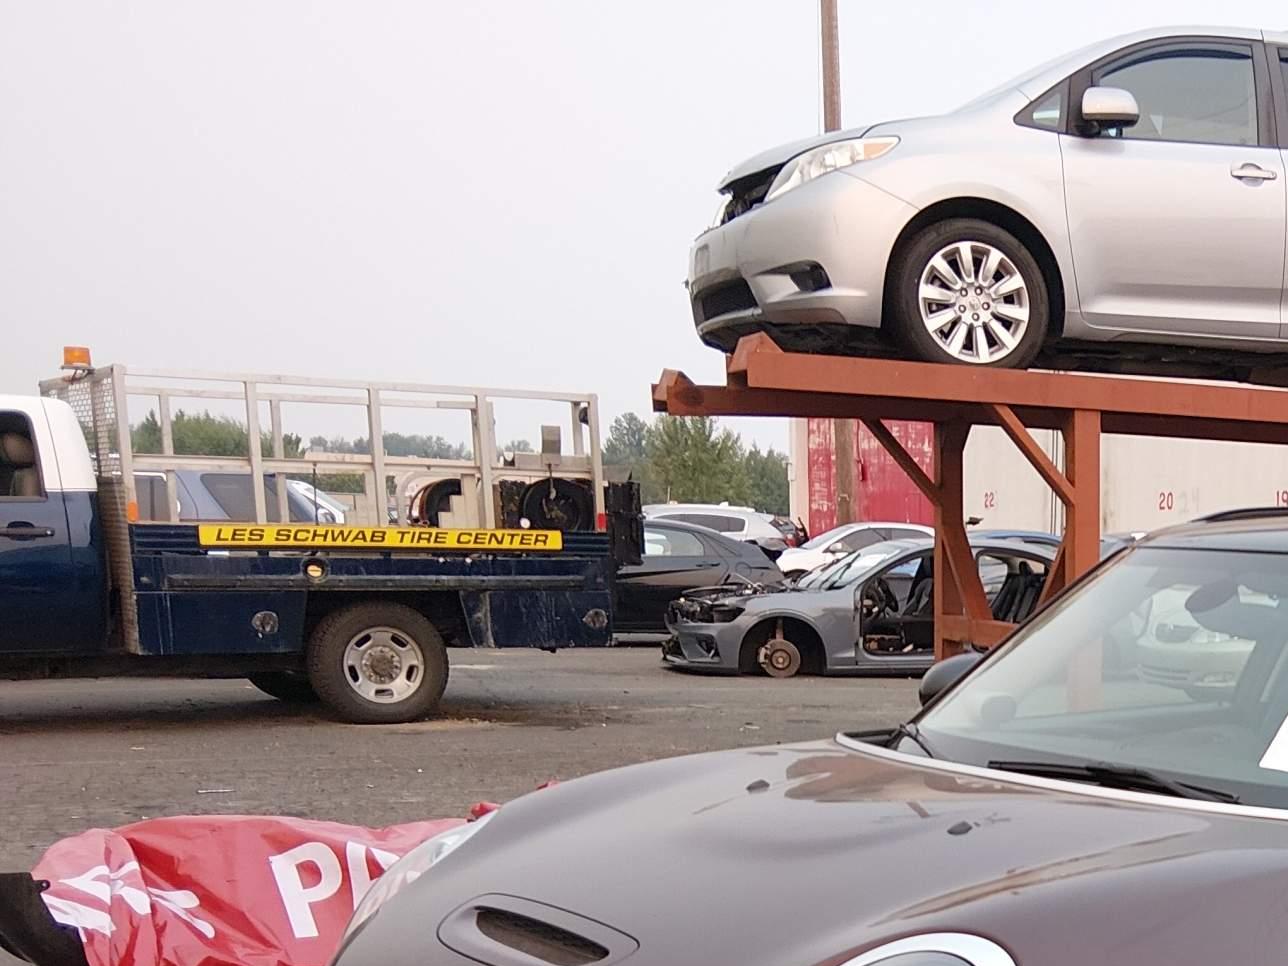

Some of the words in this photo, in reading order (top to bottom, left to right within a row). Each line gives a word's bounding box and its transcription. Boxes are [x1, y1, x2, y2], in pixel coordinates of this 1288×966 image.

[984, 492, 995, 509] 22
[1158, 491, 1174, 510] 20
[1275, 490, 1288, 507] 19
[215, 528, 265, 542] LES
[274, 528, 386, 543] SCHWAB
[396, 530, 449, 544] TIRE
[456, 532, 549, 546] CENTER
